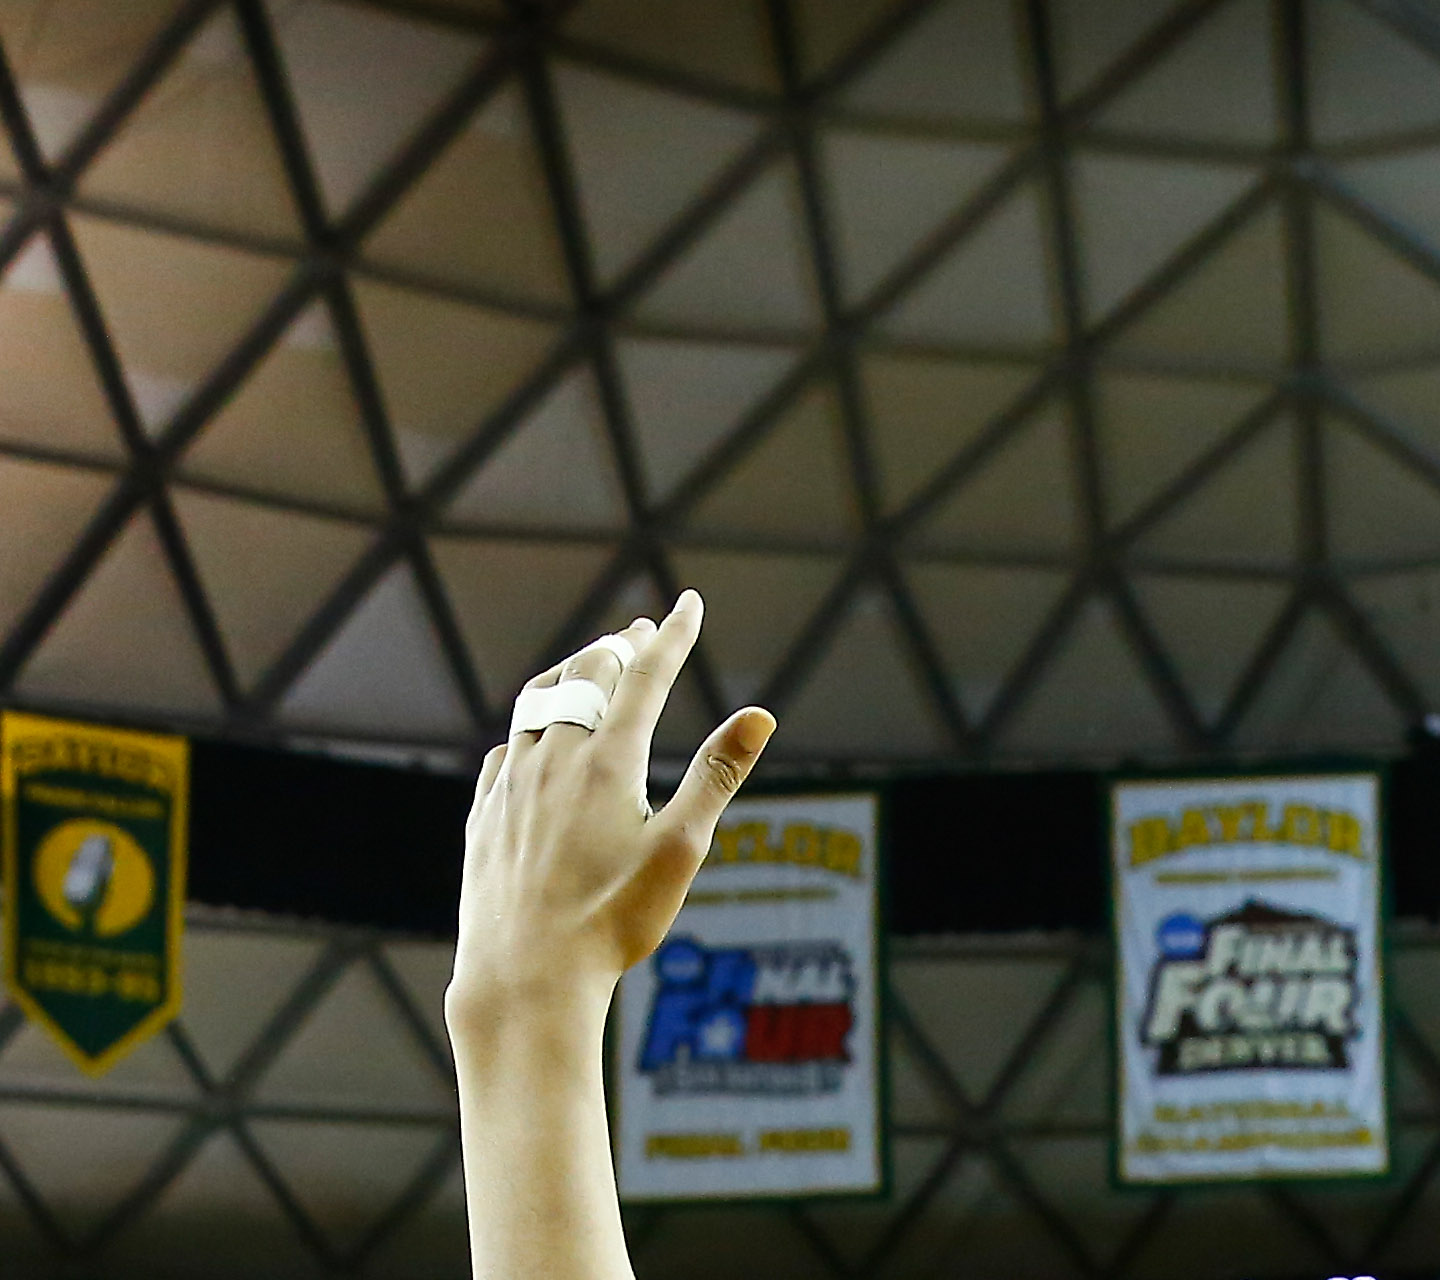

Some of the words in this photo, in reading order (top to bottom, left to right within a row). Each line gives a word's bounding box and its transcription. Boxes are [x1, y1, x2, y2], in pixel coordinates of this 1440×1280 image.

[710, 822, 863, 878] YLOR
[1129, 802, 1364, 868] BAYLOR
[1209, 924, 1348, 977] FINAL
[1148, 957, 1352, 1039] FOUR
[1176, 1035, 1330, 1071] DENVER
